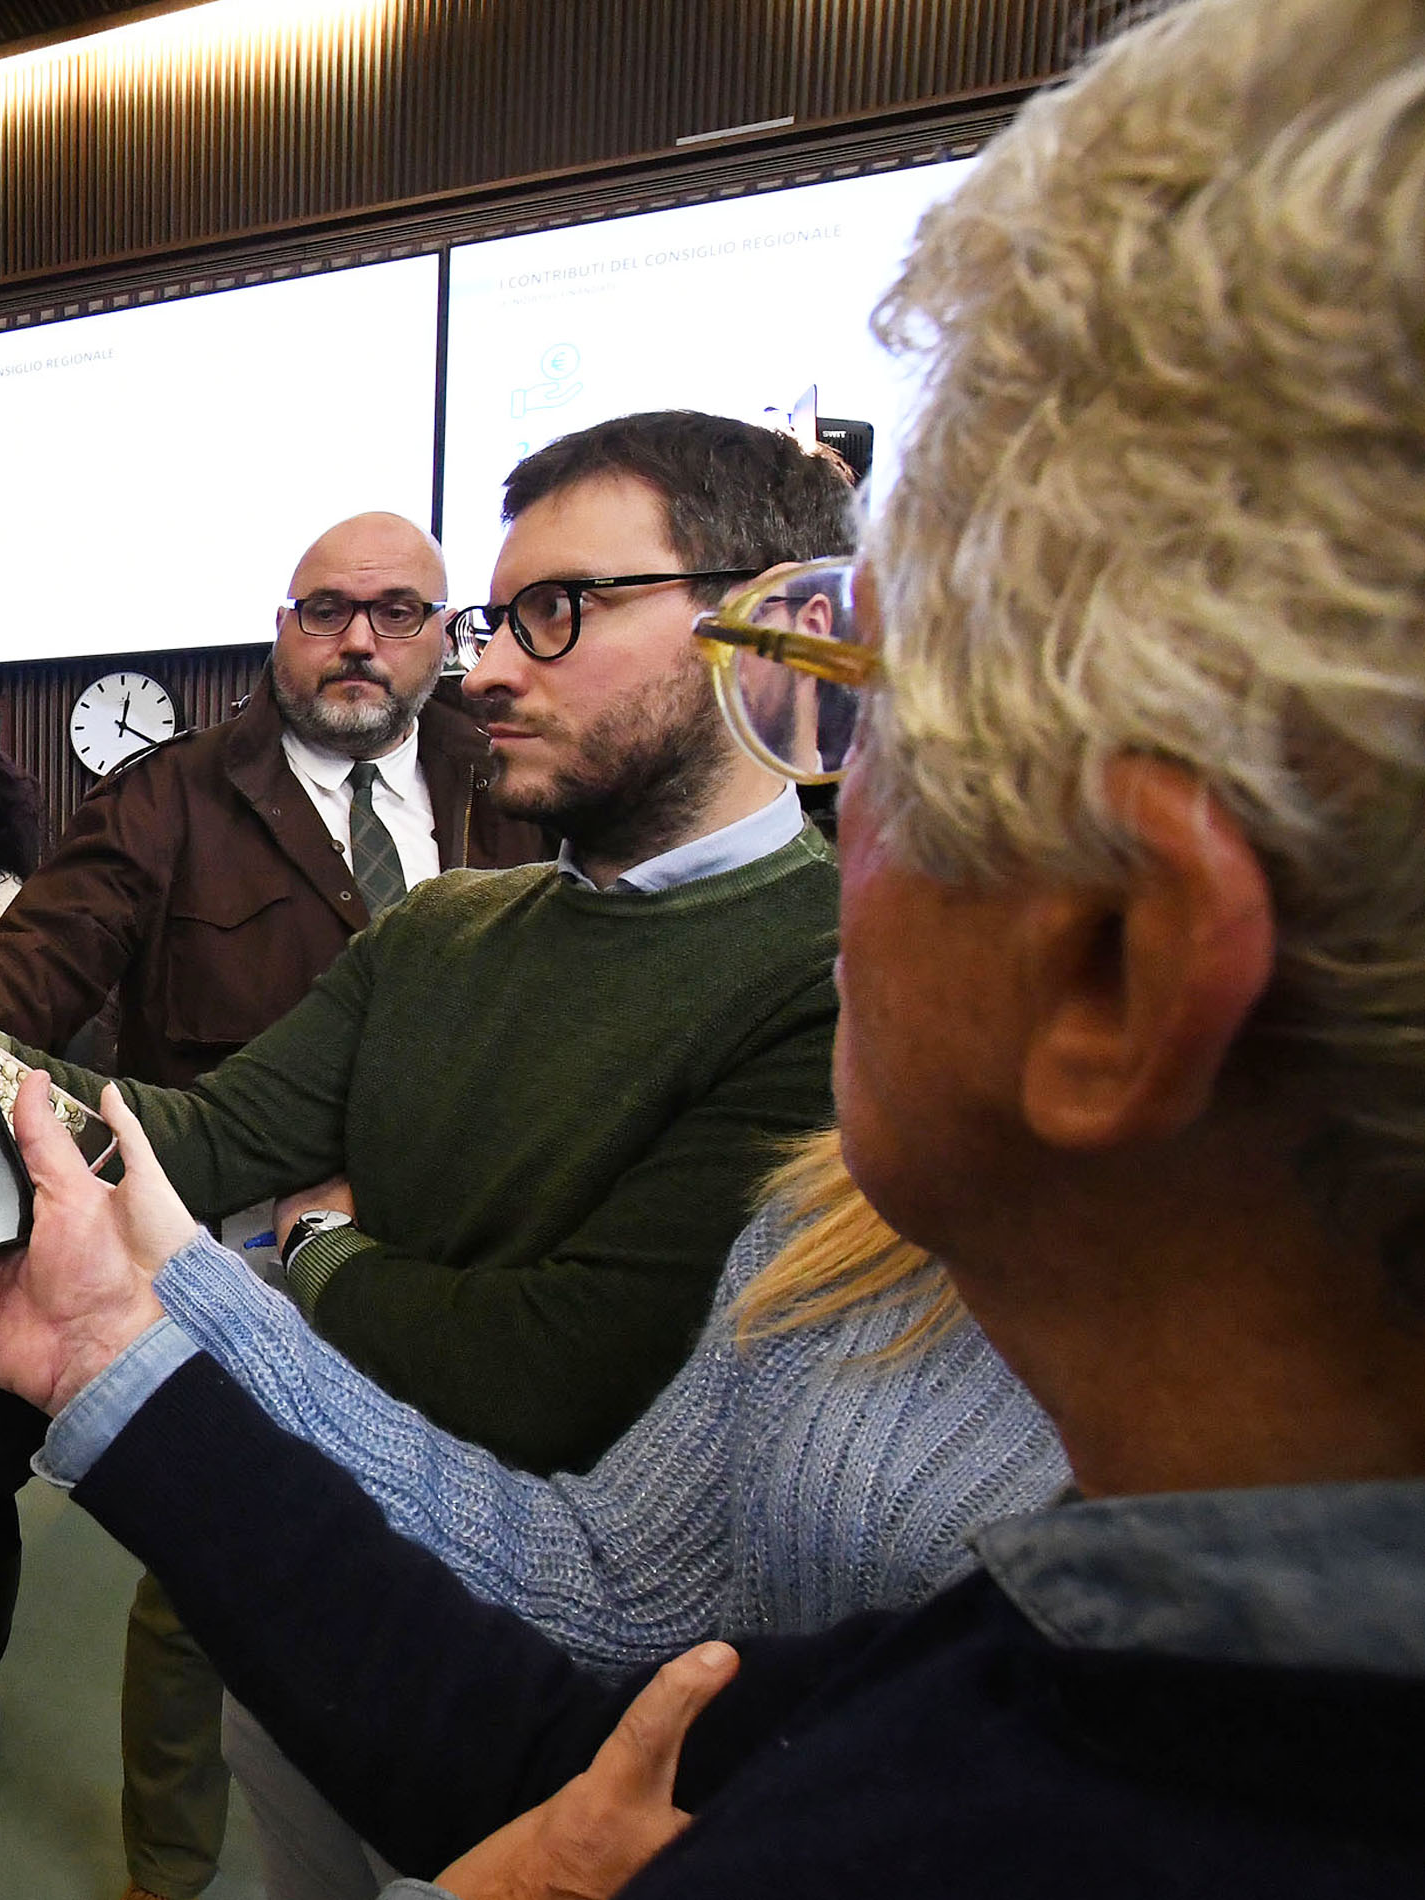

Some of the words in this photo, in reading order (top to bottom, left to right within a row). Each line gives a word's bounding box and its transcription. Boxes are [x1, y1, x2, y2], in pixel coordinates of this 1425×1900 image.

[508, 262, 606, 290] CONTRIBUTI
[610, 256, 639, 274] DEL
[645, 240, 737, 267] CONSIGLIO
[743, 223, 843, 252] REGIONALE
[46, 347, 114, 369] REGIONALE
